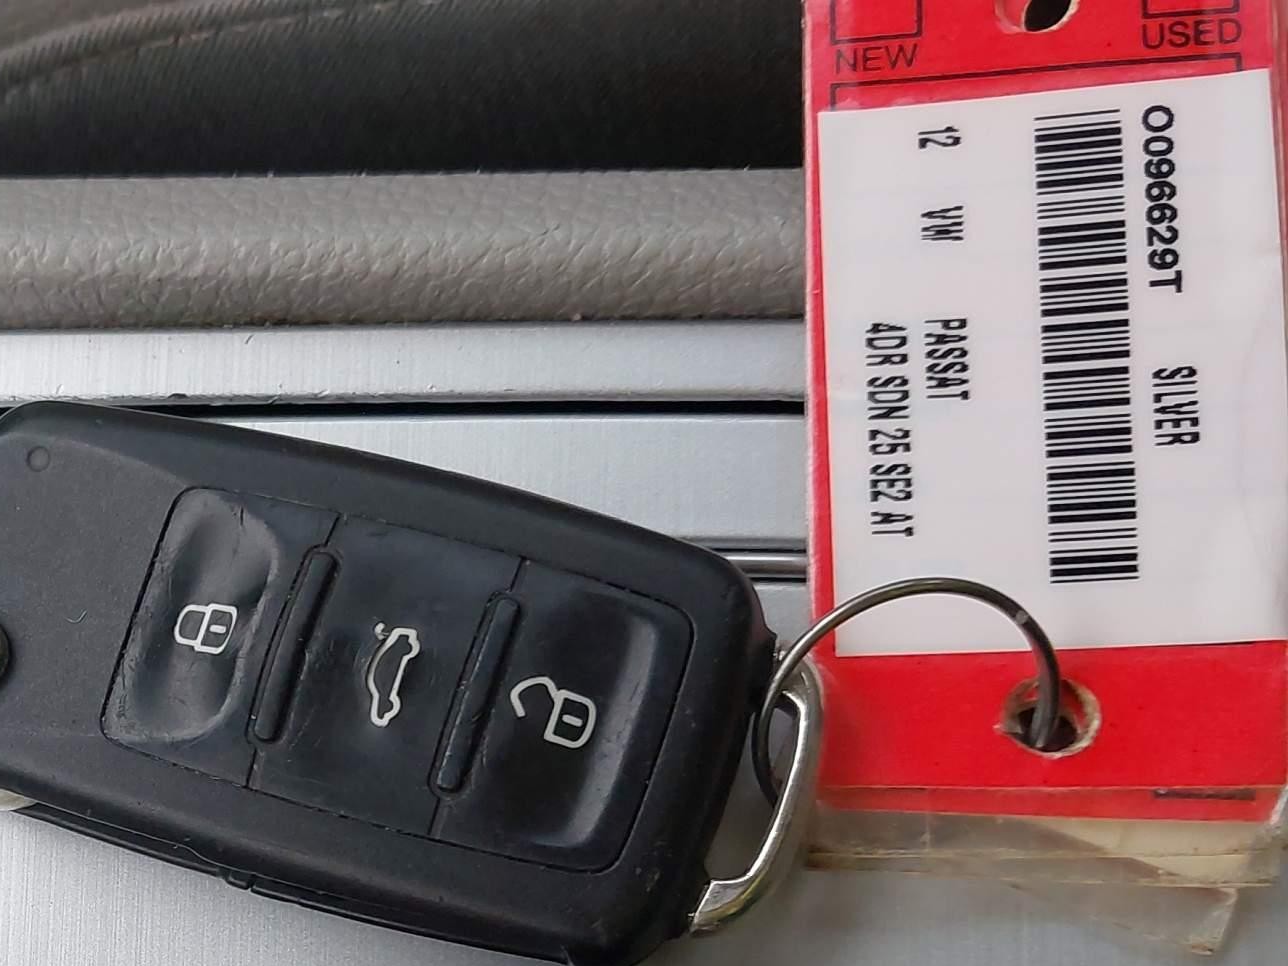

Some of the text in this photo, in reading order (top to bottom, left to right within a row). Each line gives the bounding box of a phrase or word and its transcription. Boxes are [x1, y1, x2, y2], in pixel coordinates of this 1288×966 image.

[835, 43, 917, 72] NEW
[1143, 19, 1241, 49] USED
[918, 126, 970, 400] 12 VW PASSAT
[866, 323, 914, 536] 4DR SDN 25 SE2 AT
[1152, 366, 1200, 446] SILVER
